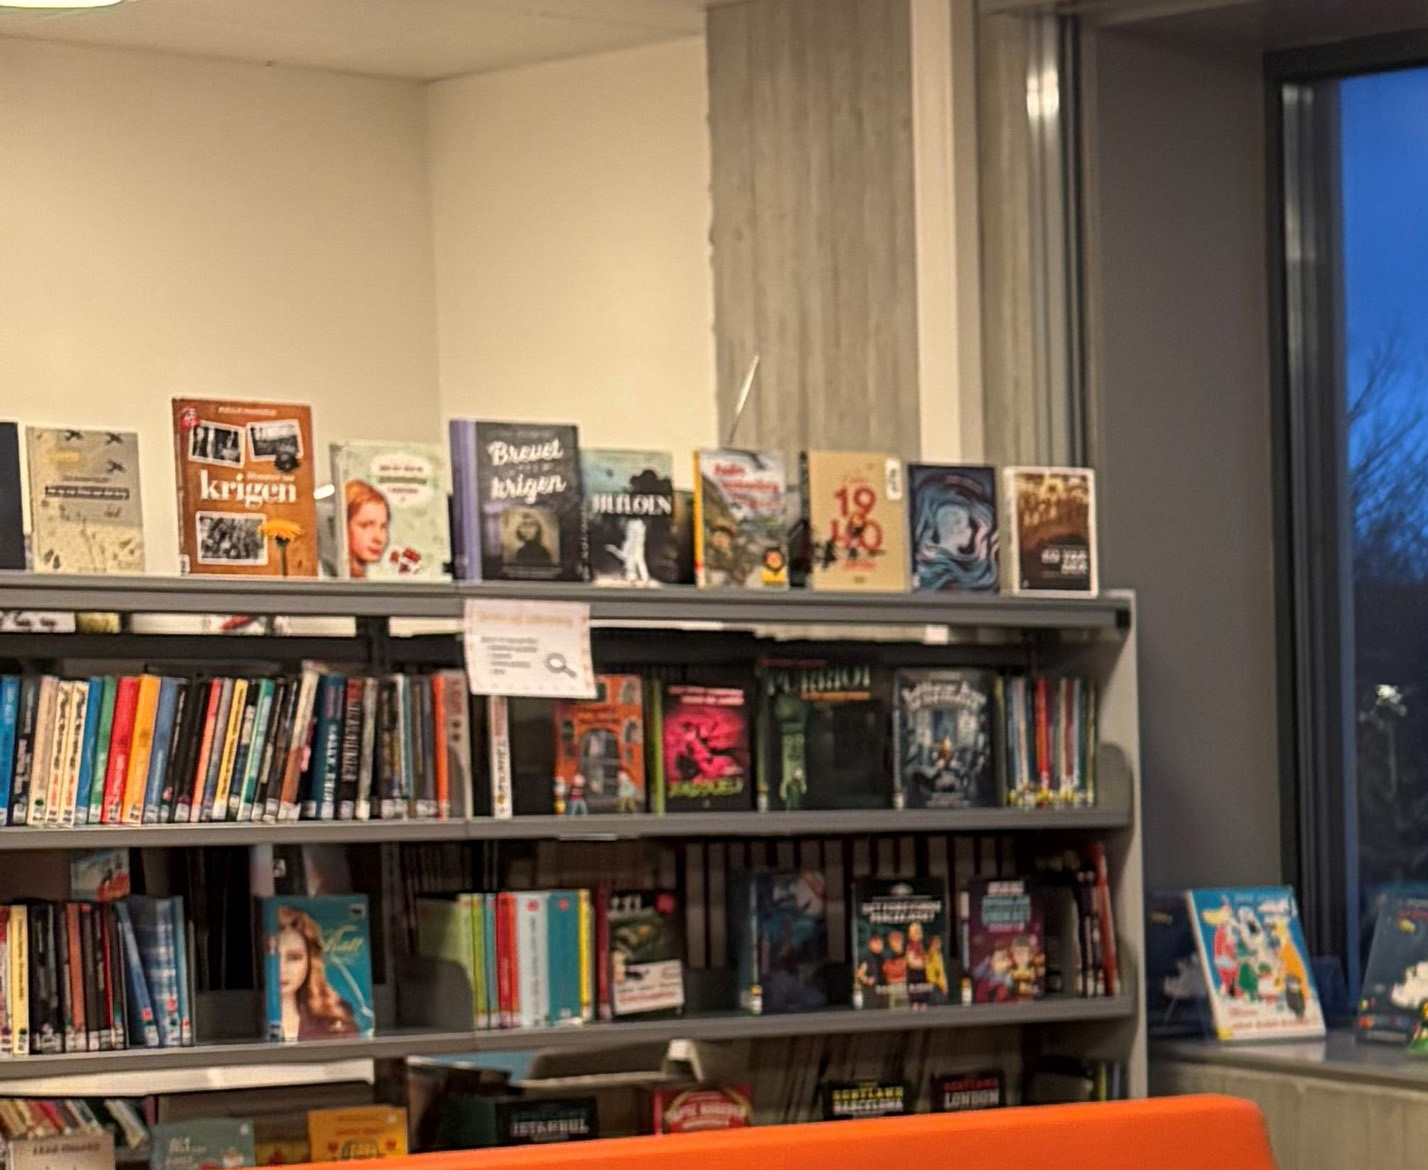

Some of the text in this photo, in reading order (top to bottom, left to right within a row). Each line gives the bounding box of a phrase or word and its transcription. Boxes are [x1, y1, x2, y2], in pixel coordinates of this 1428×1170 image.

[199, 469, 297, 510] krigen
[490, 473, 567, 505] krigen
[833, 486, 877, 517] 19
